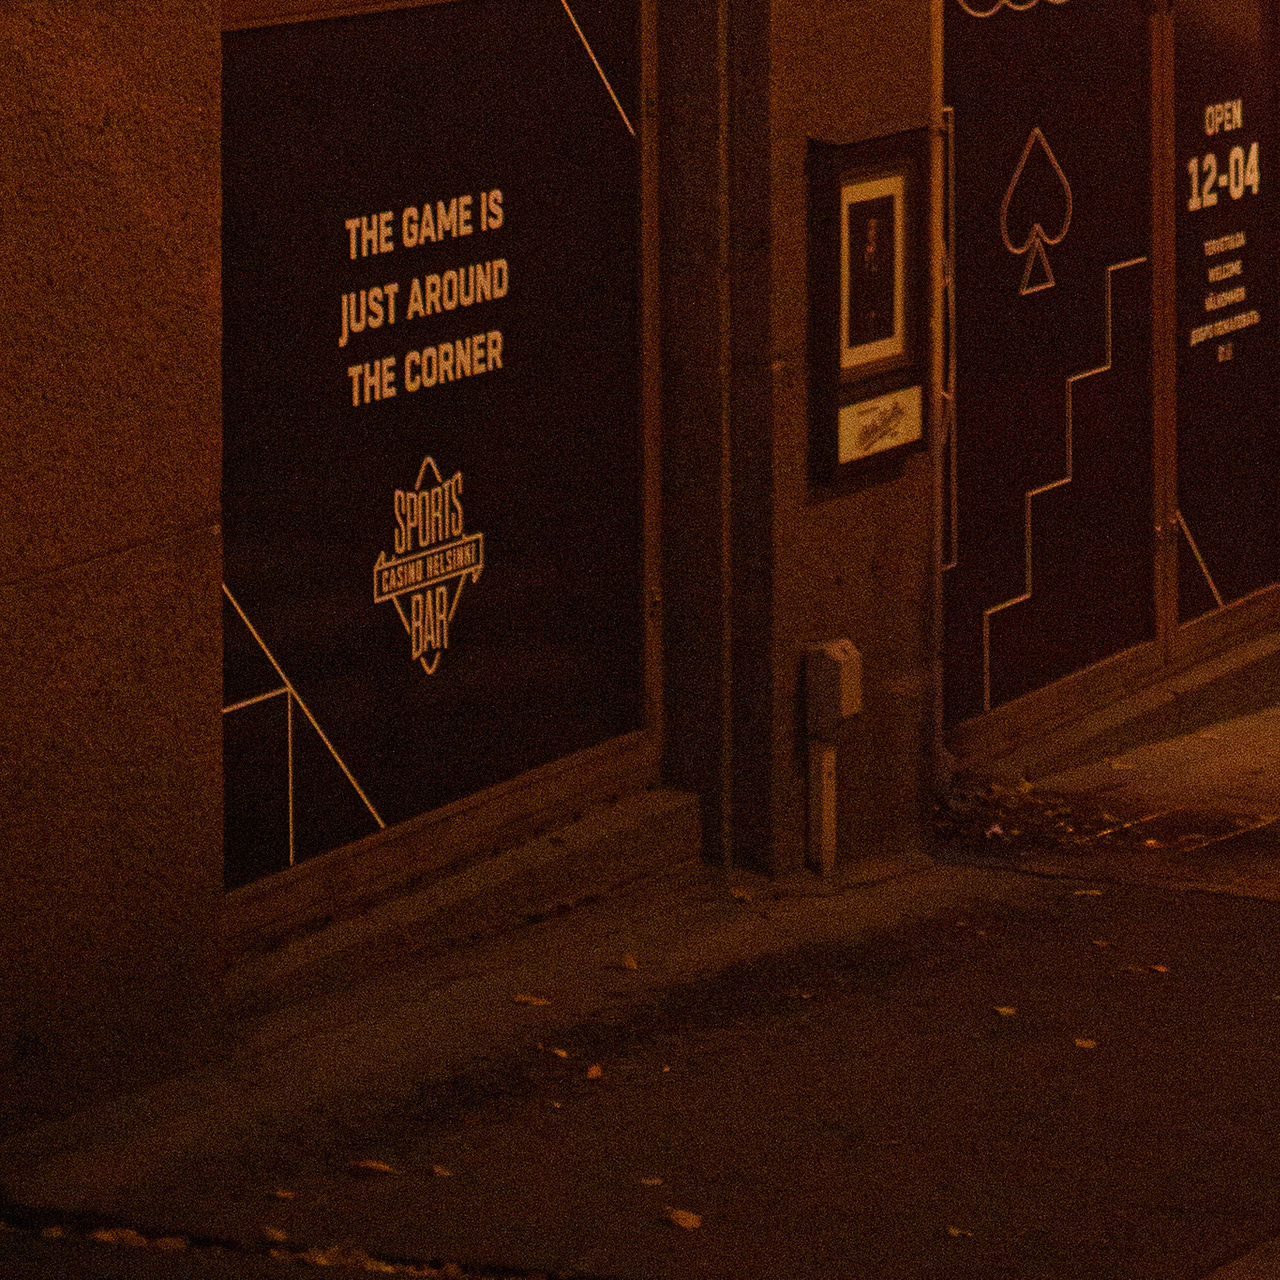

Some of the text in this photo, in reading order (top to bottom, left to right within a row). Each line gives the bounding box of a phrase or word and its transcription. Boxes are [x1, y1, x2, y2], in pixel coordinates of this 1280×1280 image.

[1205, 99, 1243, 136] OPEN
[1188, 142, 1260, 212] 12-04
[345, 189, 503, 260] THE GAME IS
[338, 258, 508, 348] JUST AROUND
[348, 331, 503, 407] THE CORNER
[394, 471, 463, 554] SPORTS
[382, 543, 476, 593] CASINO HELSINKI
[411, 586, 448, 660] BAR
